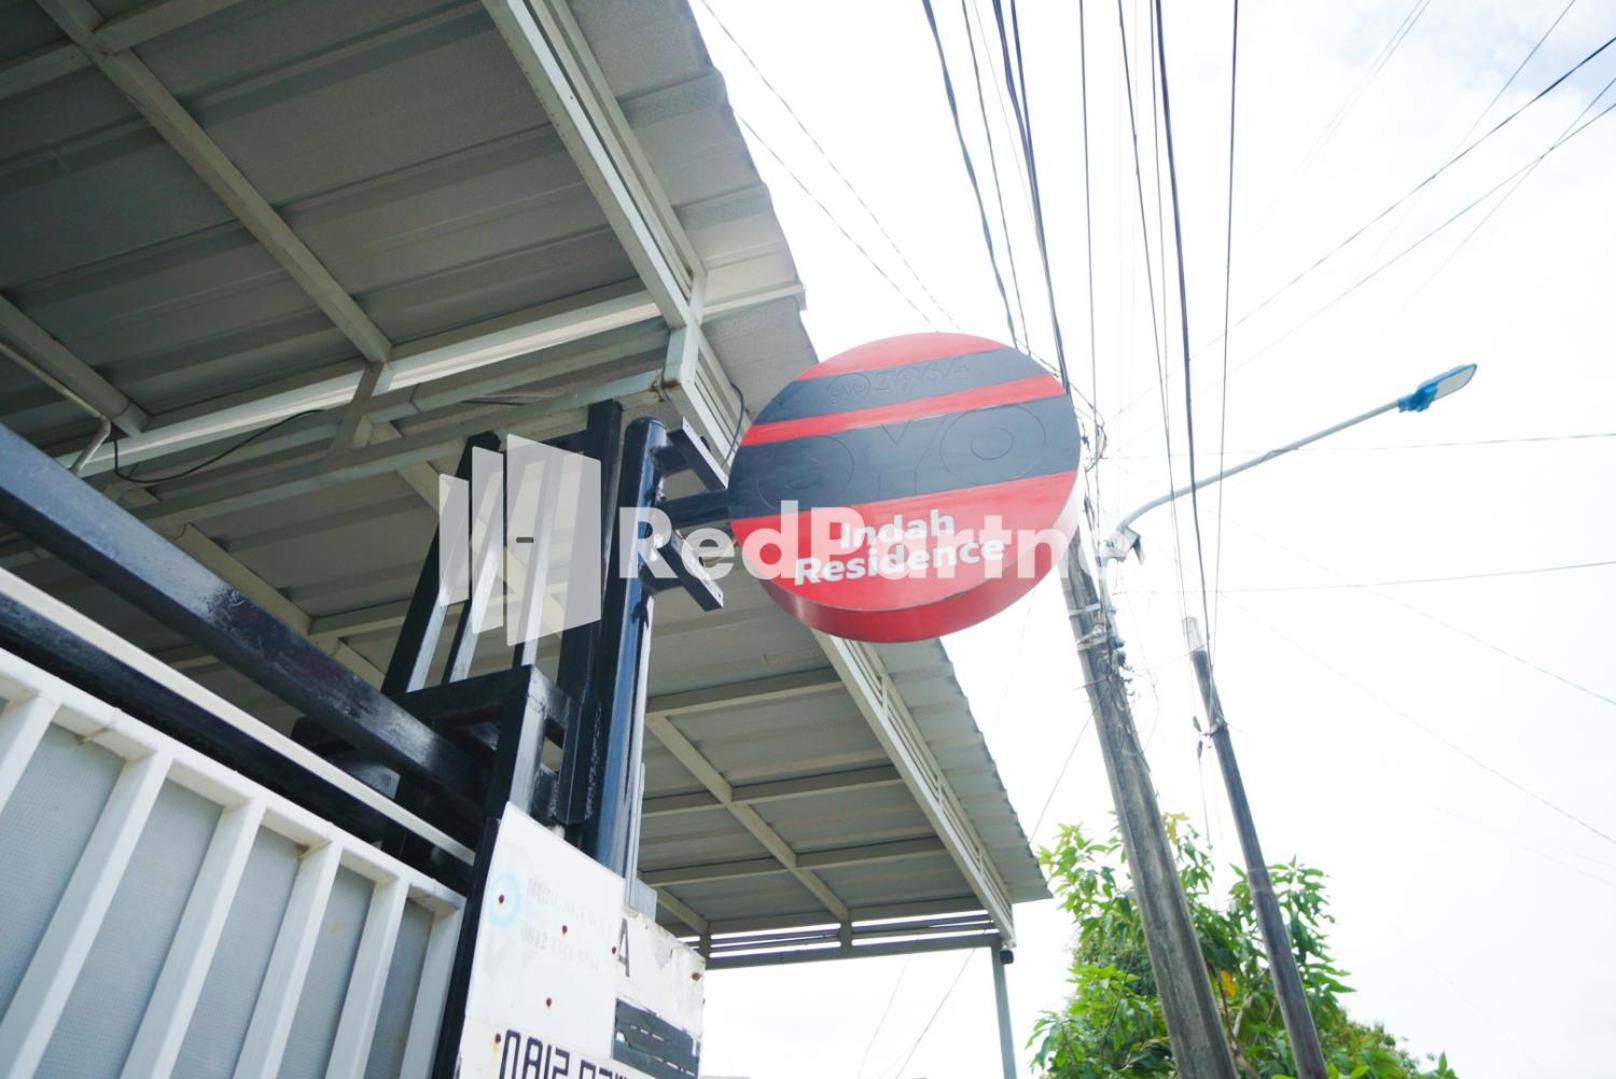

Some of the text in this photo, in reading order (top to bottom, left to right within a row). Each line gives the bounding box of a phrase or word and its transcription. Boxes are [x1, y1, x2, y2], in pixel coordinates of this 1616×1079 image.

[757, 405, 1046, 512] OYO
[839, 508, 955, 549] Indah
[793, 538, 1005, 586] Residence
